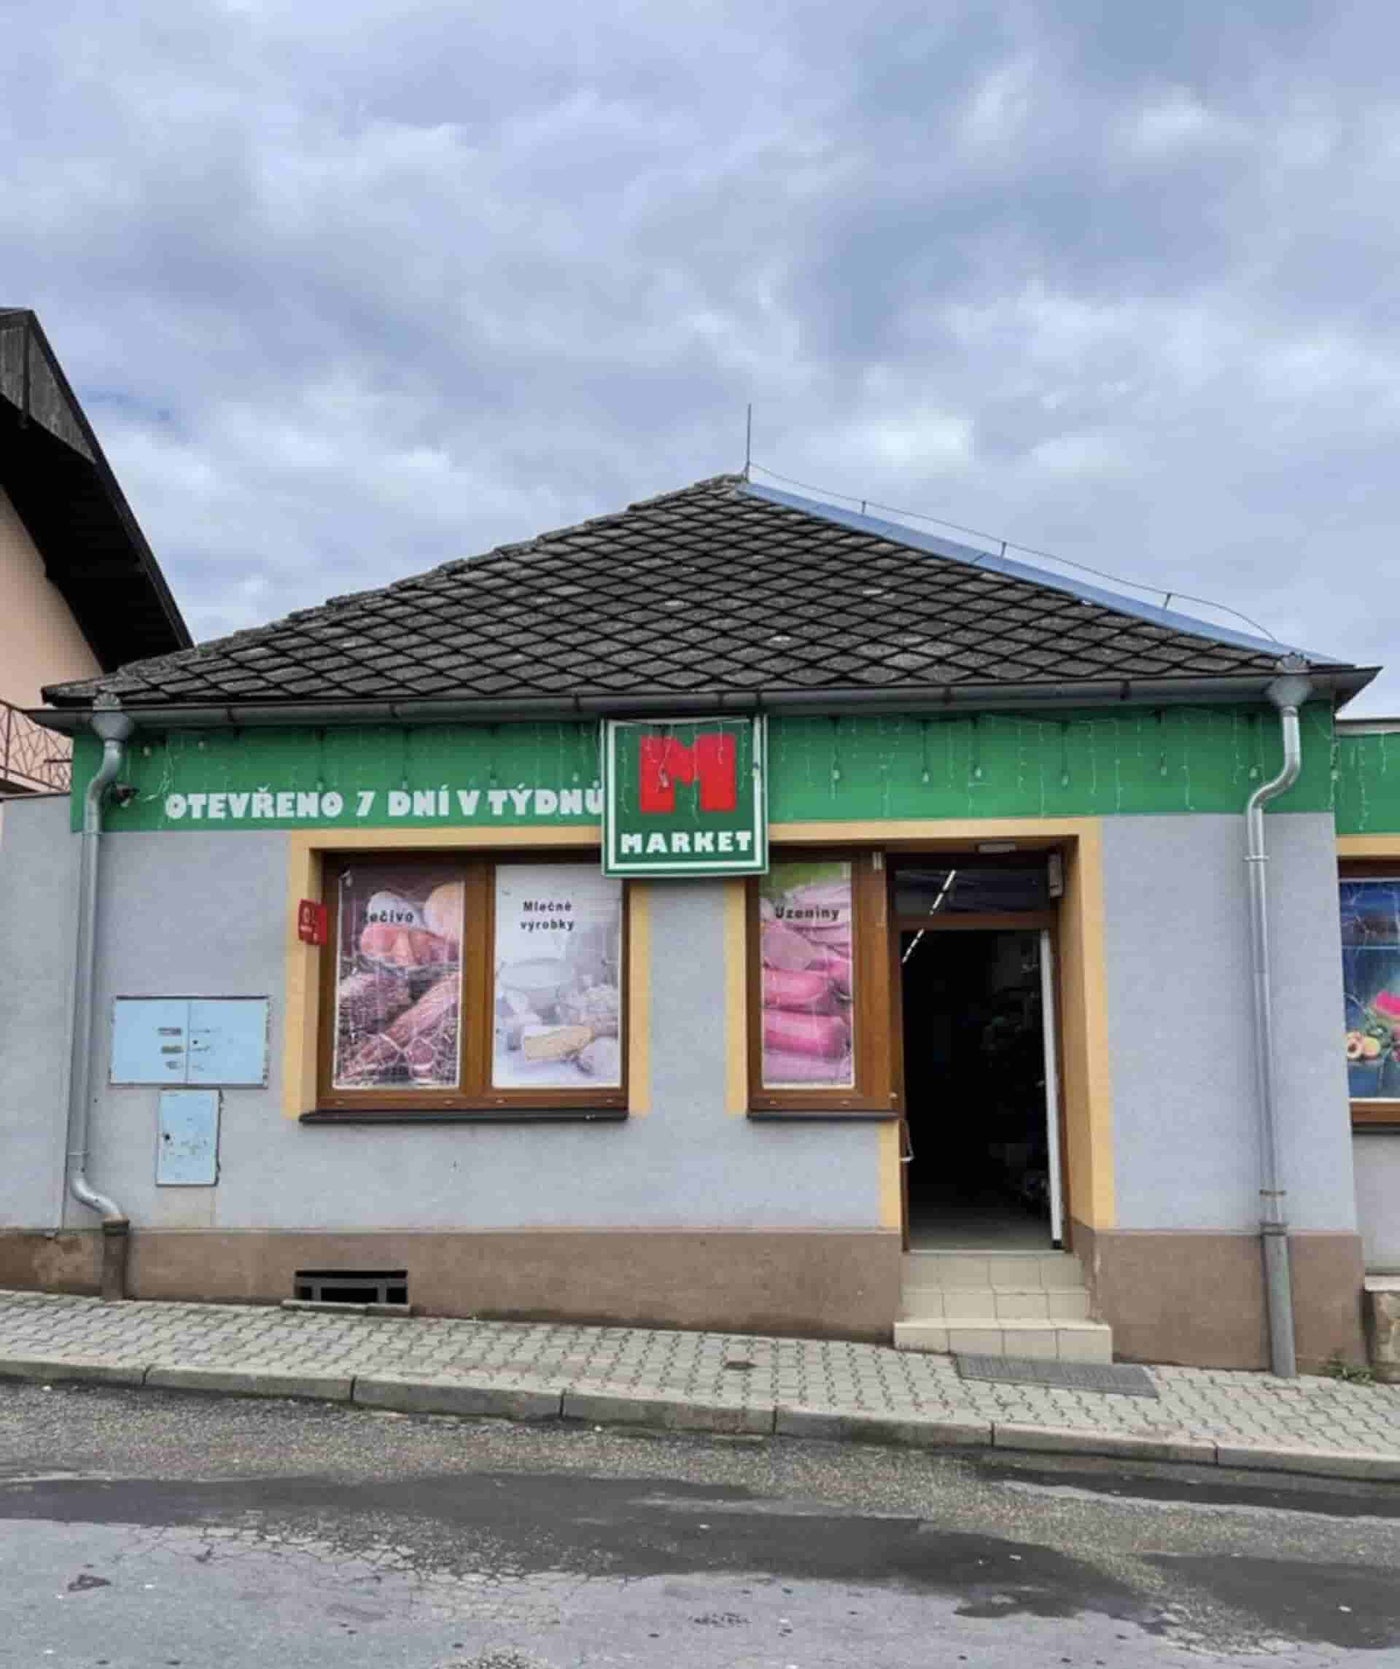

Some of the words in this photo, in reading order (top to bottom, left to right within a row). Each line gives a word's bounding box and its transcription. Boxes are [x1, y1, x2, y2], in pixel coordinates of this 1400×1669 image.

[640, 733, 736, 814] M
[165, 783, 344, 819] OTEVŘENO
[356, 790, 376, 817] 7
[388, 784, 449, 817] DNÍ
[457, 790, 480, 815] V
[620, 831, 752, 854] MARKET
[775, 904, 840, 921] Uzeniny
